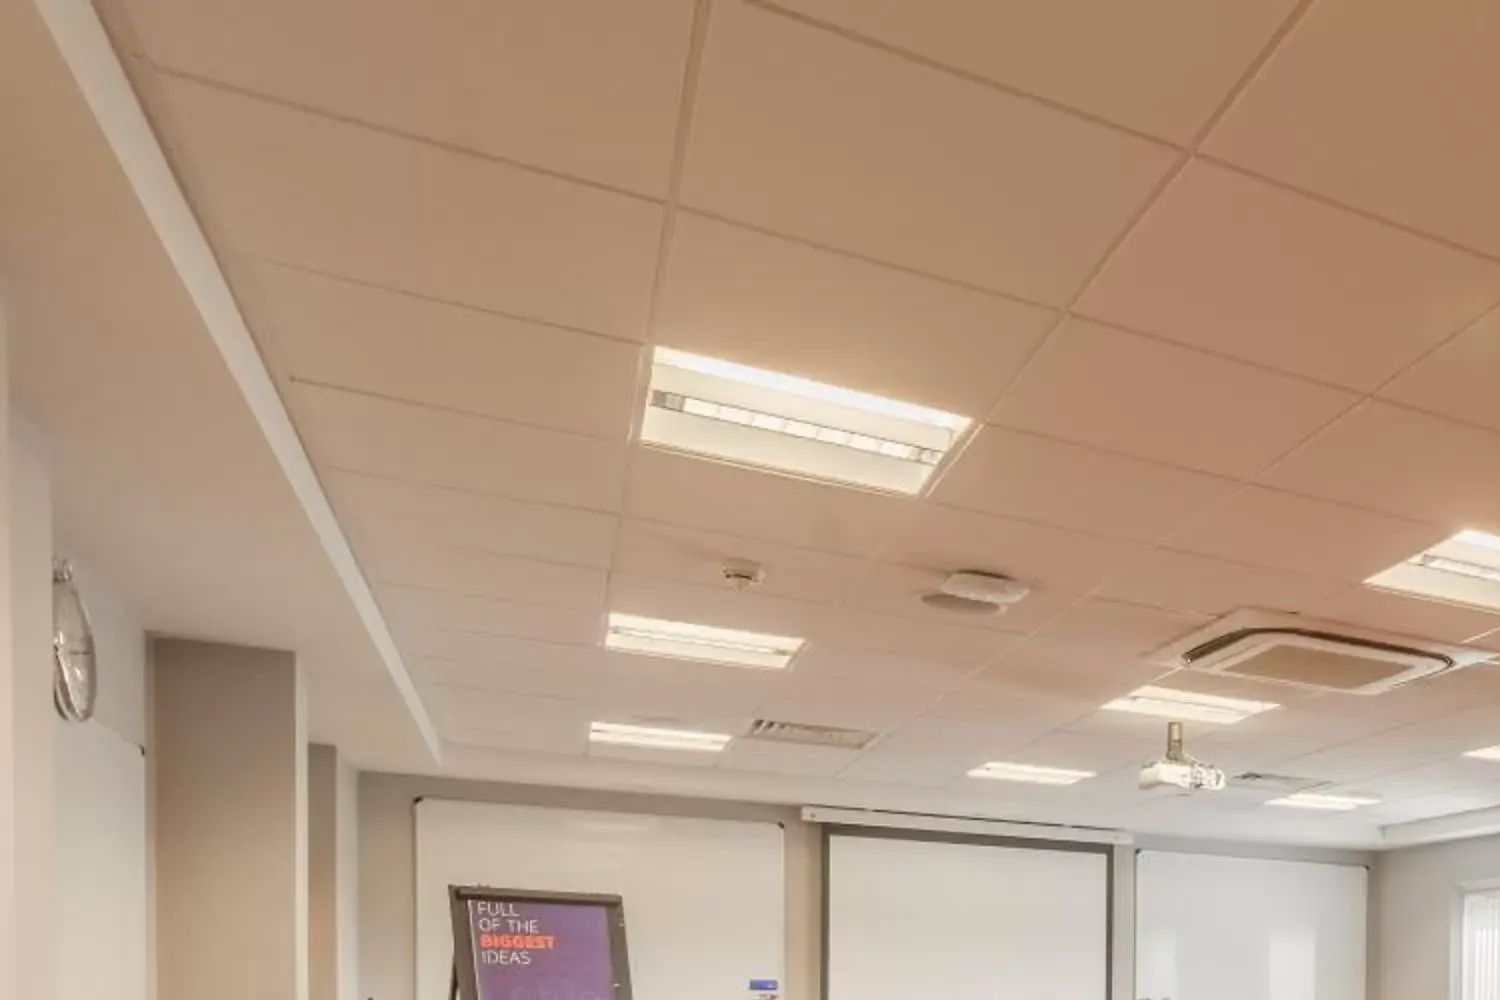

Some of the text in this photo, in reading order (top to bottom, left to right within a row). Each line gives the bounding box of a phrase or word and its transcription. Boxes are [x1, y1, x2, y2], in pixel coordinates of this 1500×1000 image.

[477, 901, 520, 917] FULL
[479, 918, 539, 934] OF THE
[480, 934, 554, 949] BIGGEST
[481, 950, 532, 965] IDEAS
